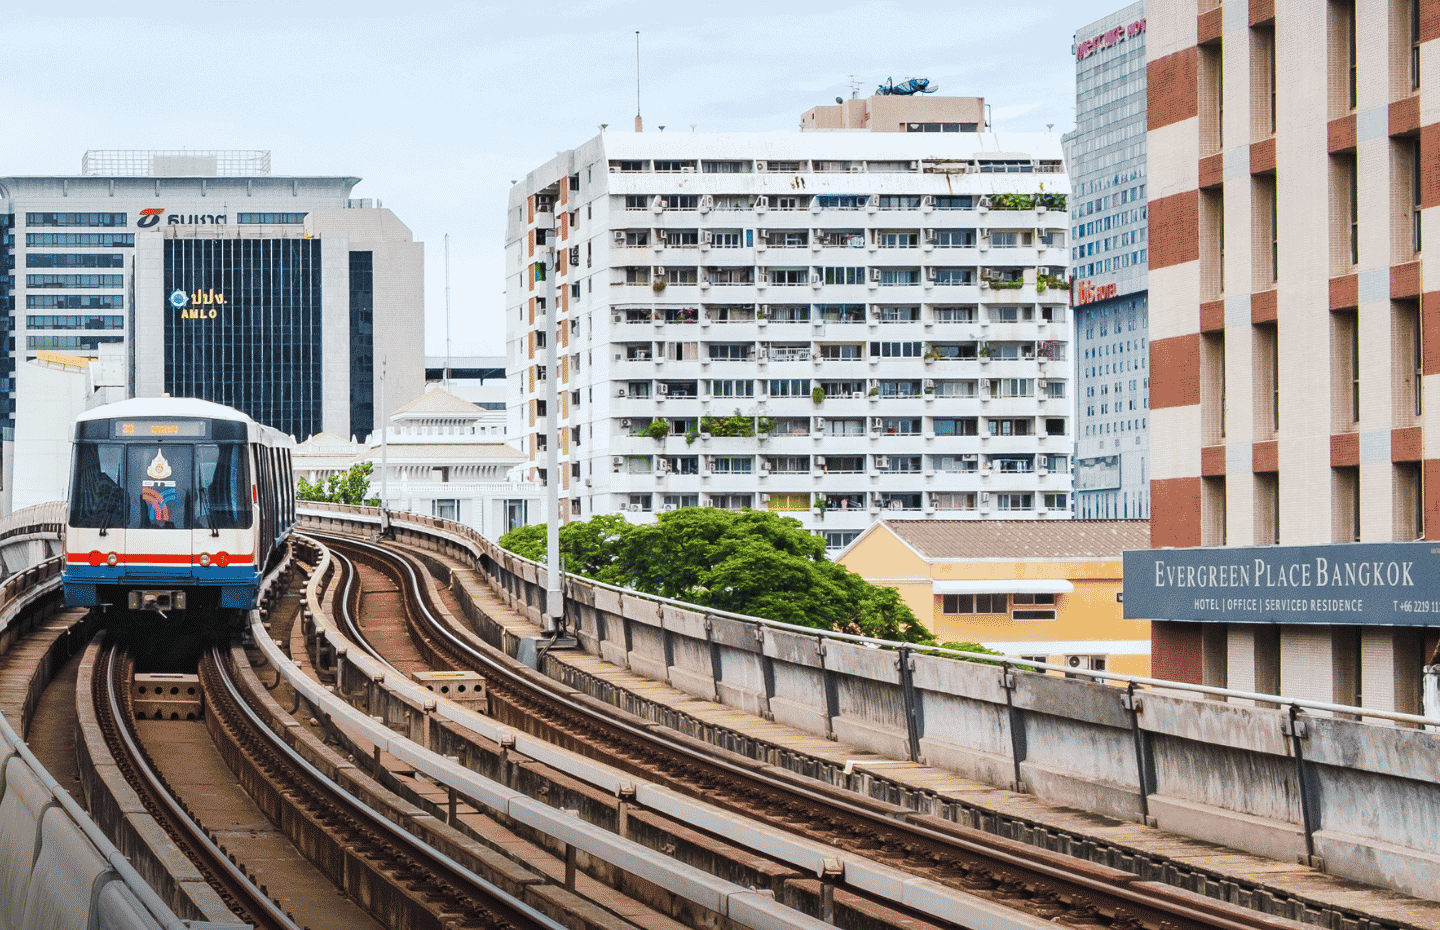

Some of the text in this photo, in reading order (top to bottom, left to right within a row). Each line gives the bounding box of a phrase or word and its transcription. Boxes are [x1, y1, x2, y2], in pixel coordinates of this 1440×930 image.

[1127, 18, 1147, 38] HOT
[190, 288, 228, 305] ปปง.
[180, 308, 218, 319] AMLO
[1154, 556, 1416, 588] EVERGREEN PLACE BANGKOK
[1194, 598, 1364, 613] HOTEL OFFICE SERVICED RESIDENCE
[1393, 600, 1440, 613] T +66 2219 11
